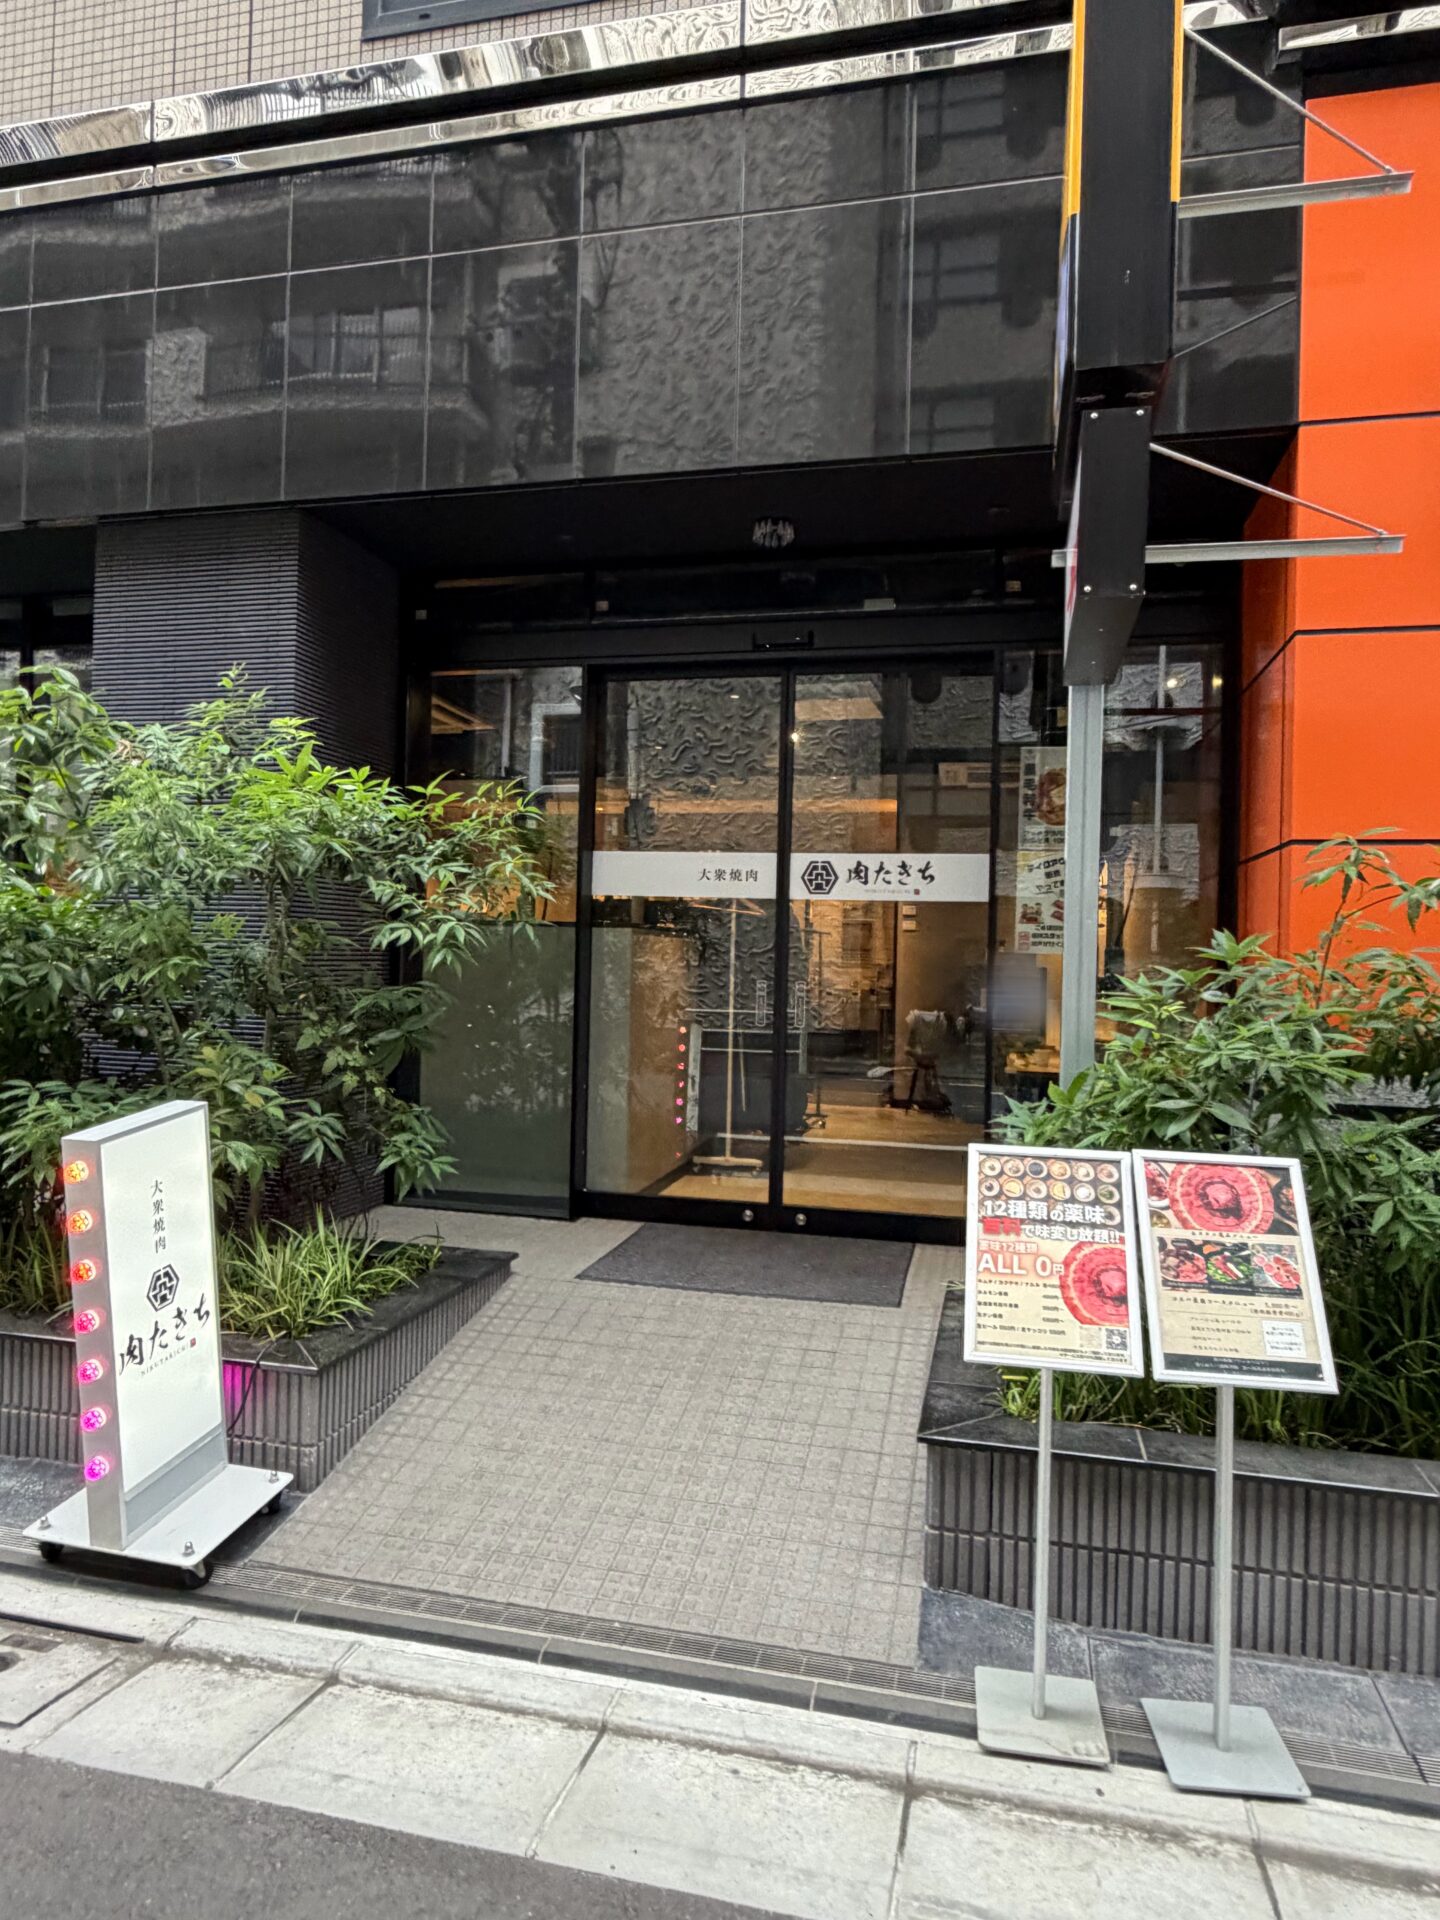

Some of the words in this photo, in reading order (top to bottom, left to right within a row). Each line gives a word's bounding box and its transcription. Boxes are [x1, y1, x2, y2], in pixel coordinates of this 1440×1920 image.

[983, 1199, 1105, 1224] 12種類の薬味
[978, 1254, 1027, 1275] ALL
[1035, 1256, 1064, 1276] 0円
